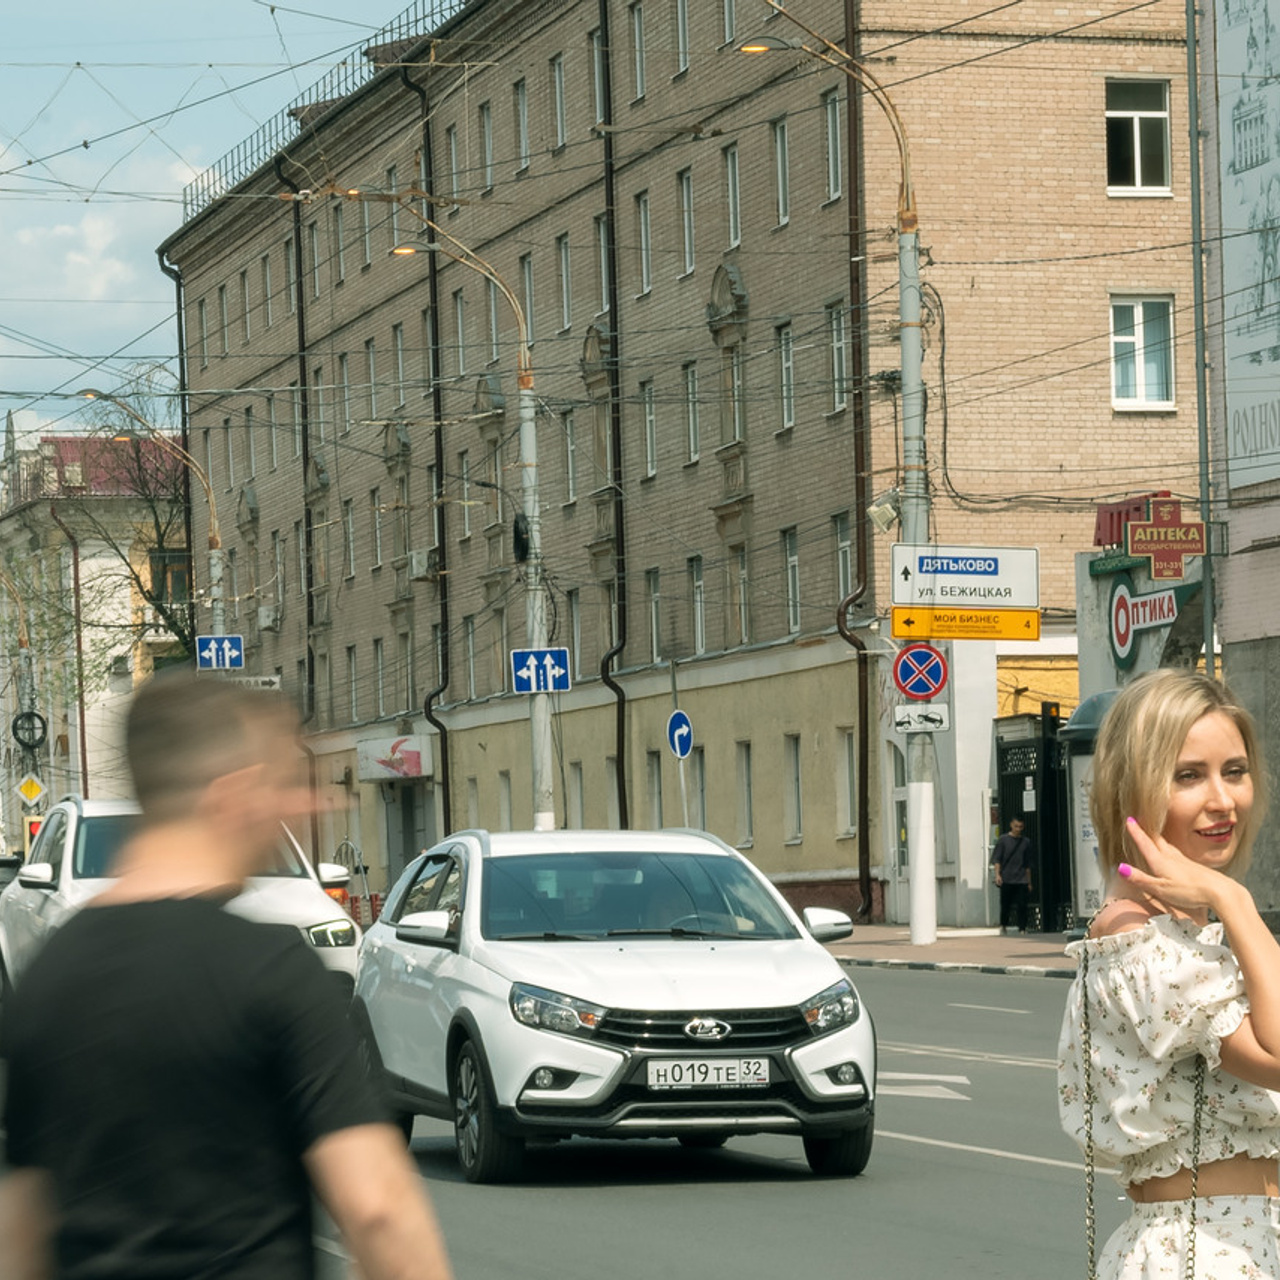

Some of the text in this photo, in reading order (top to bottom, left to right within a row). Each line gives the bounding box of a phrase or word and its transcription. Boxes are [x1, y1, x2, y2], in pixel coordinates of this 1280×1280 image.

[1134, 527, 1200, 541] АПТЕКА
[922, 558, 996, 572] ДЯТЬКОВО
[918, 586, 1012, 598] ул. БЕЖИЦКАЯ
[934, 613, 1000, 624] МОЙ БИЗНЕС
[1024, 620, 1031, 629] 4
[1115, 594, 1176, 648] ОПТИКА
